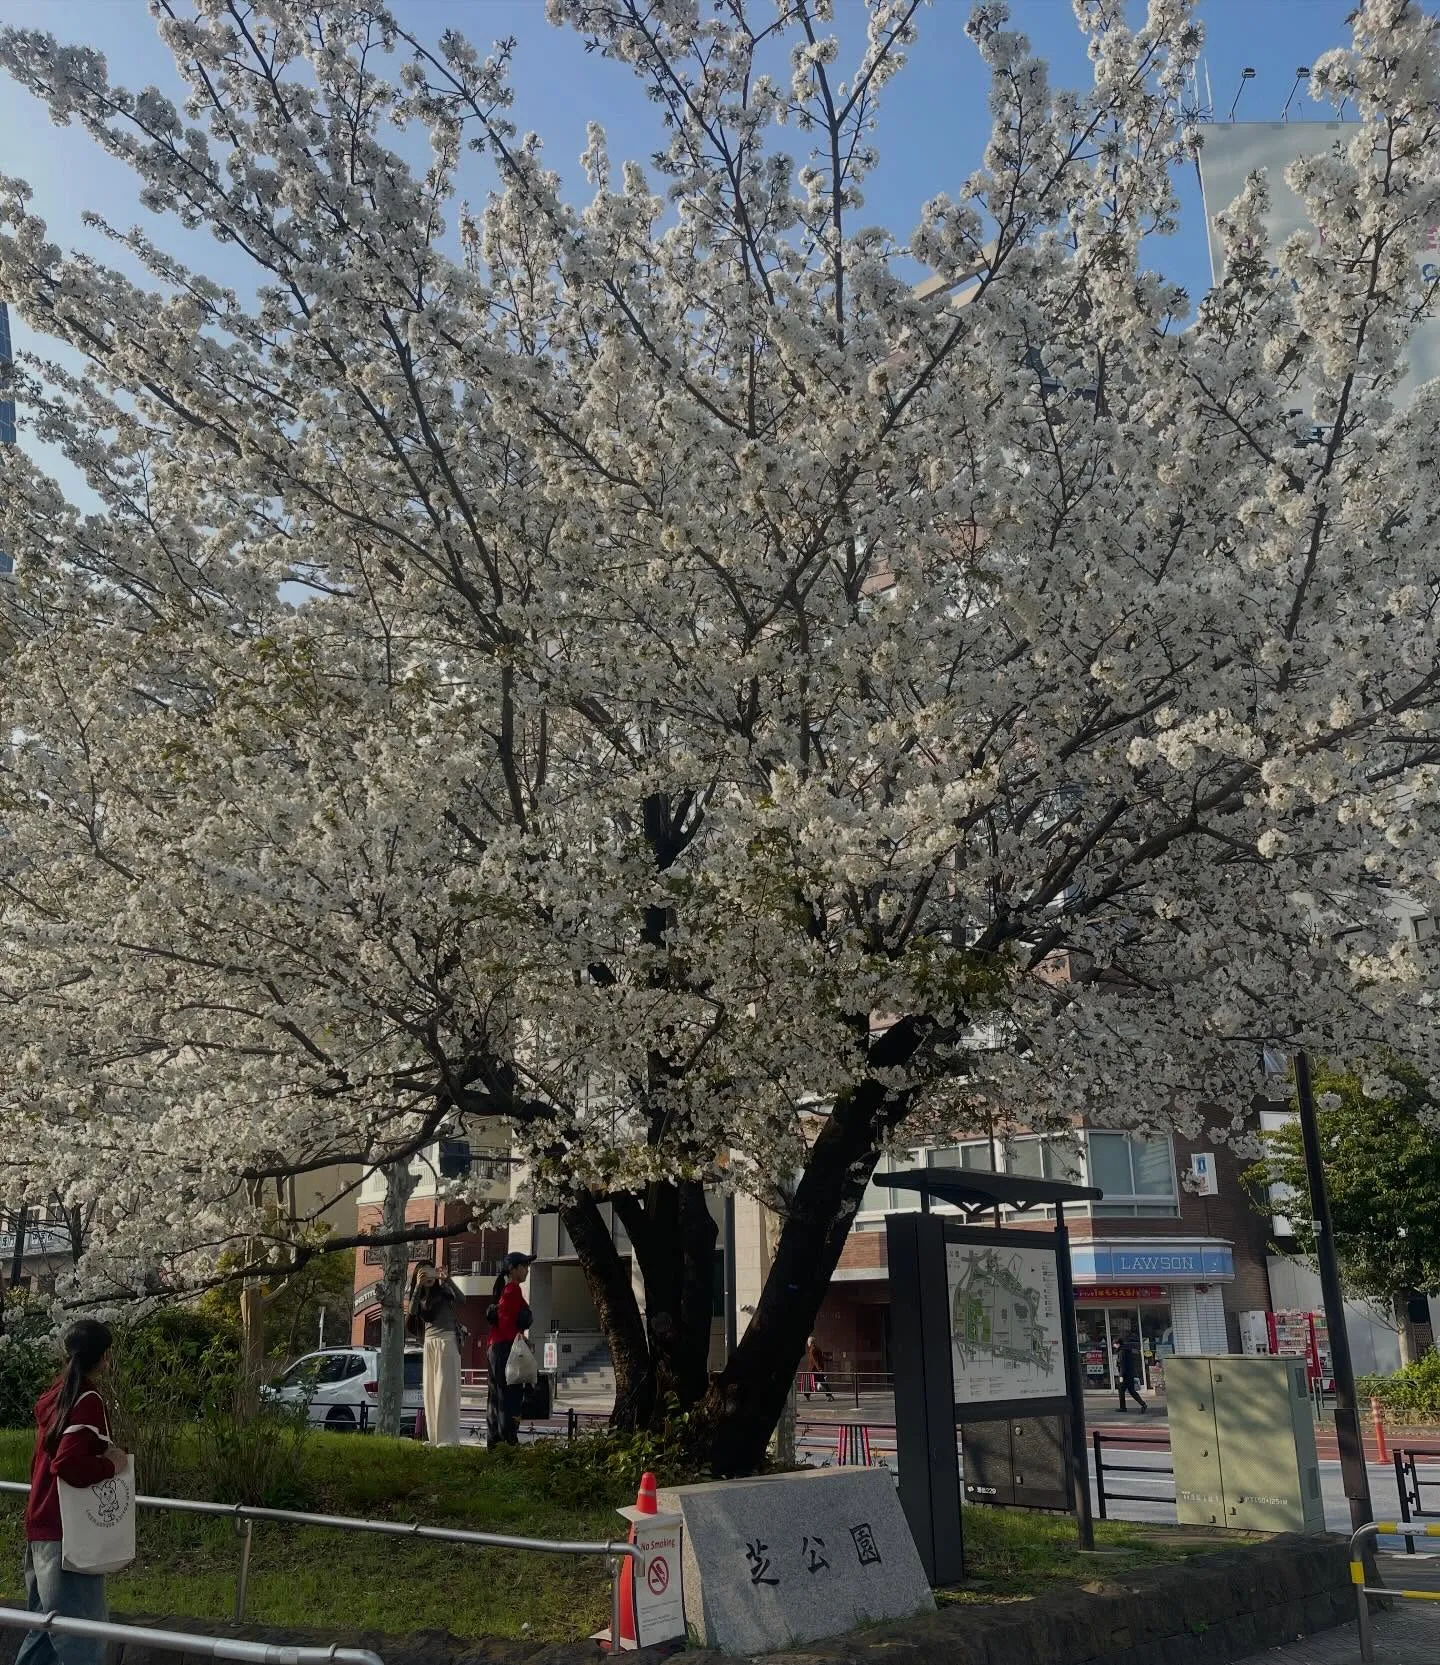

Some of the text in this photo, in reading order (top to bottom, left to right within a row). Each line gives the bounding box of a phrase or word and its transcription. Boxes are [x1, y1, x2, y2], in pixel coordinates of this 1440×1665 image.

[1120, 1256, 1194, 1270] LAWSON
[640, 1538, 676, 1552] No Smoking
[745, 1522, 882, 1586] 芝公園
